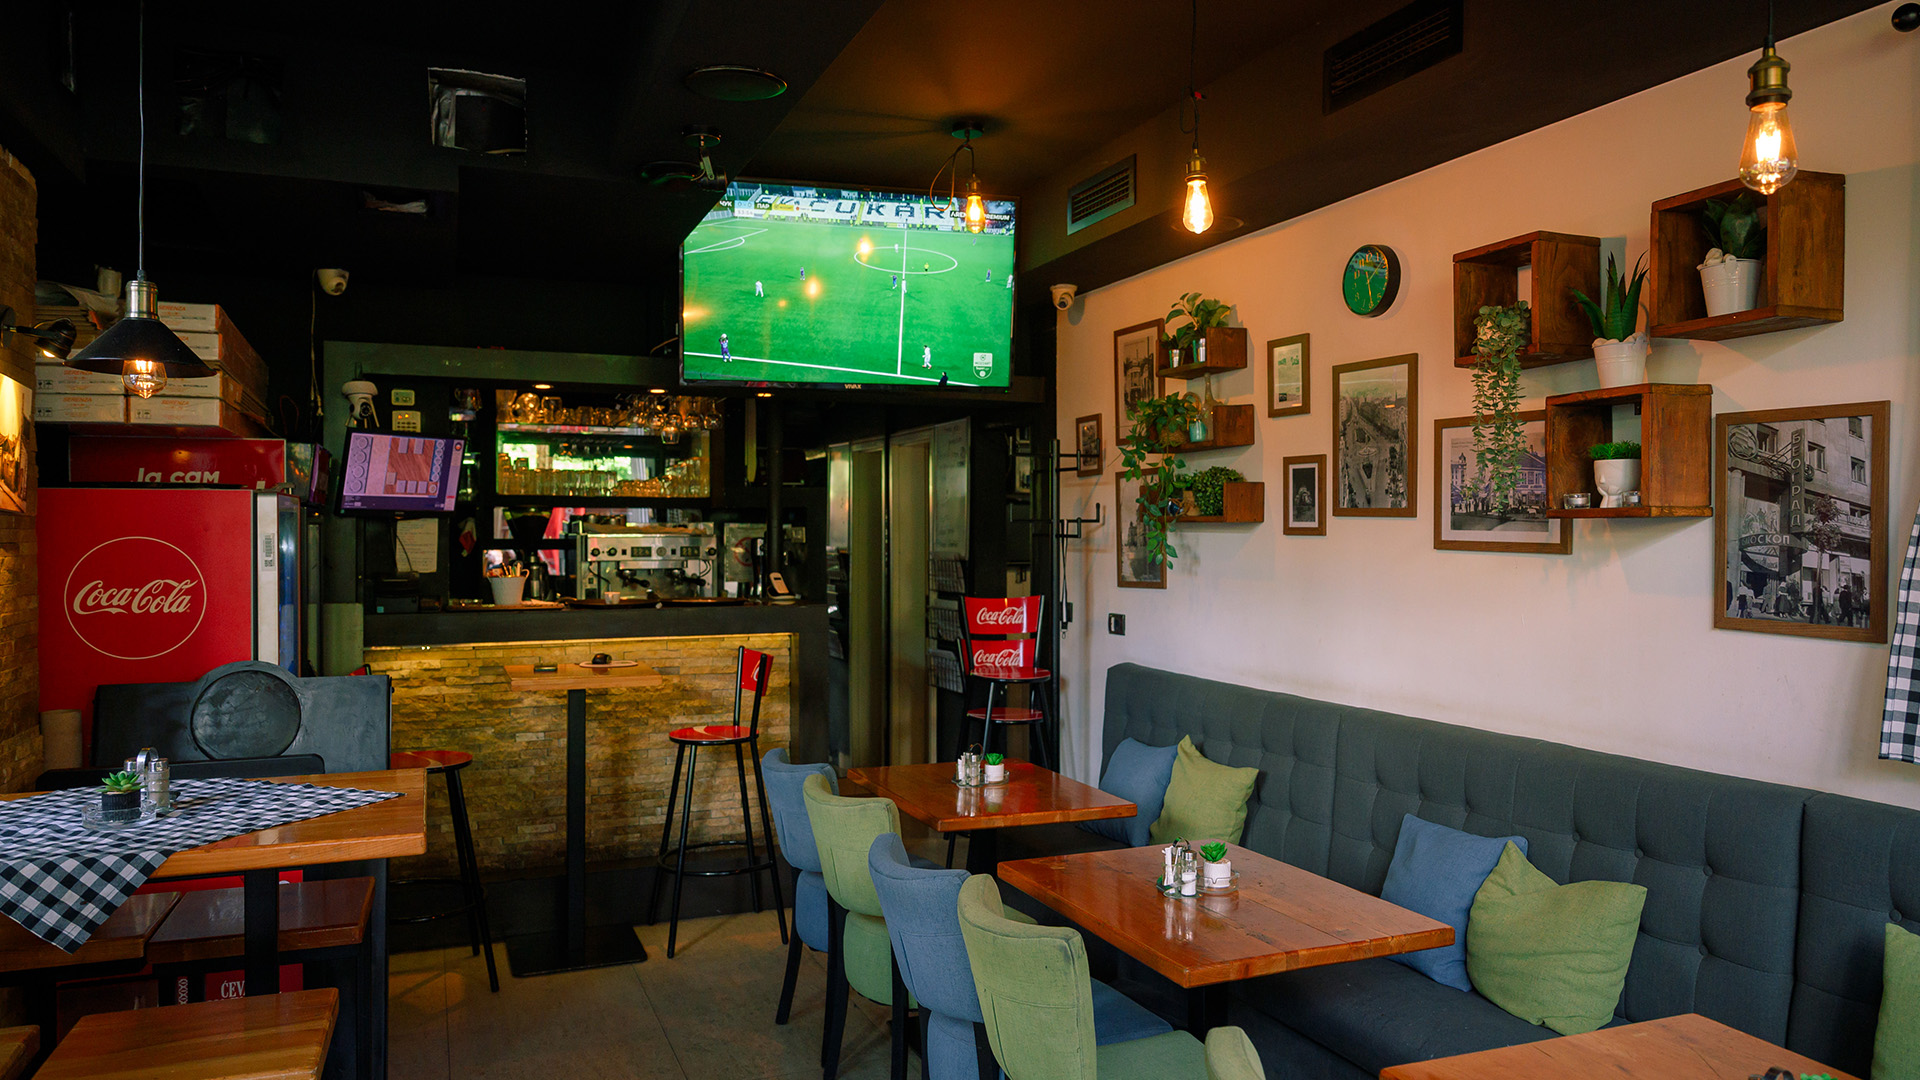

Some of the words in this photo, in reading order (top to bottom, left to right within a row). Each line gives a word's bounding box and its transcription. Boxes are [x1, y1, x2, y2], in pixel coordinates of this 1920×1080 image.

[1791, 432, 1802, 528] БЕОГРАД
[73, 579, 199, 615] Coca-Cola
[976, 606, 1025, 625] Coca-Cola
[973, 648, 1020, 667] Coca-Cola
[220, 980, 246, 998] ĆEV
